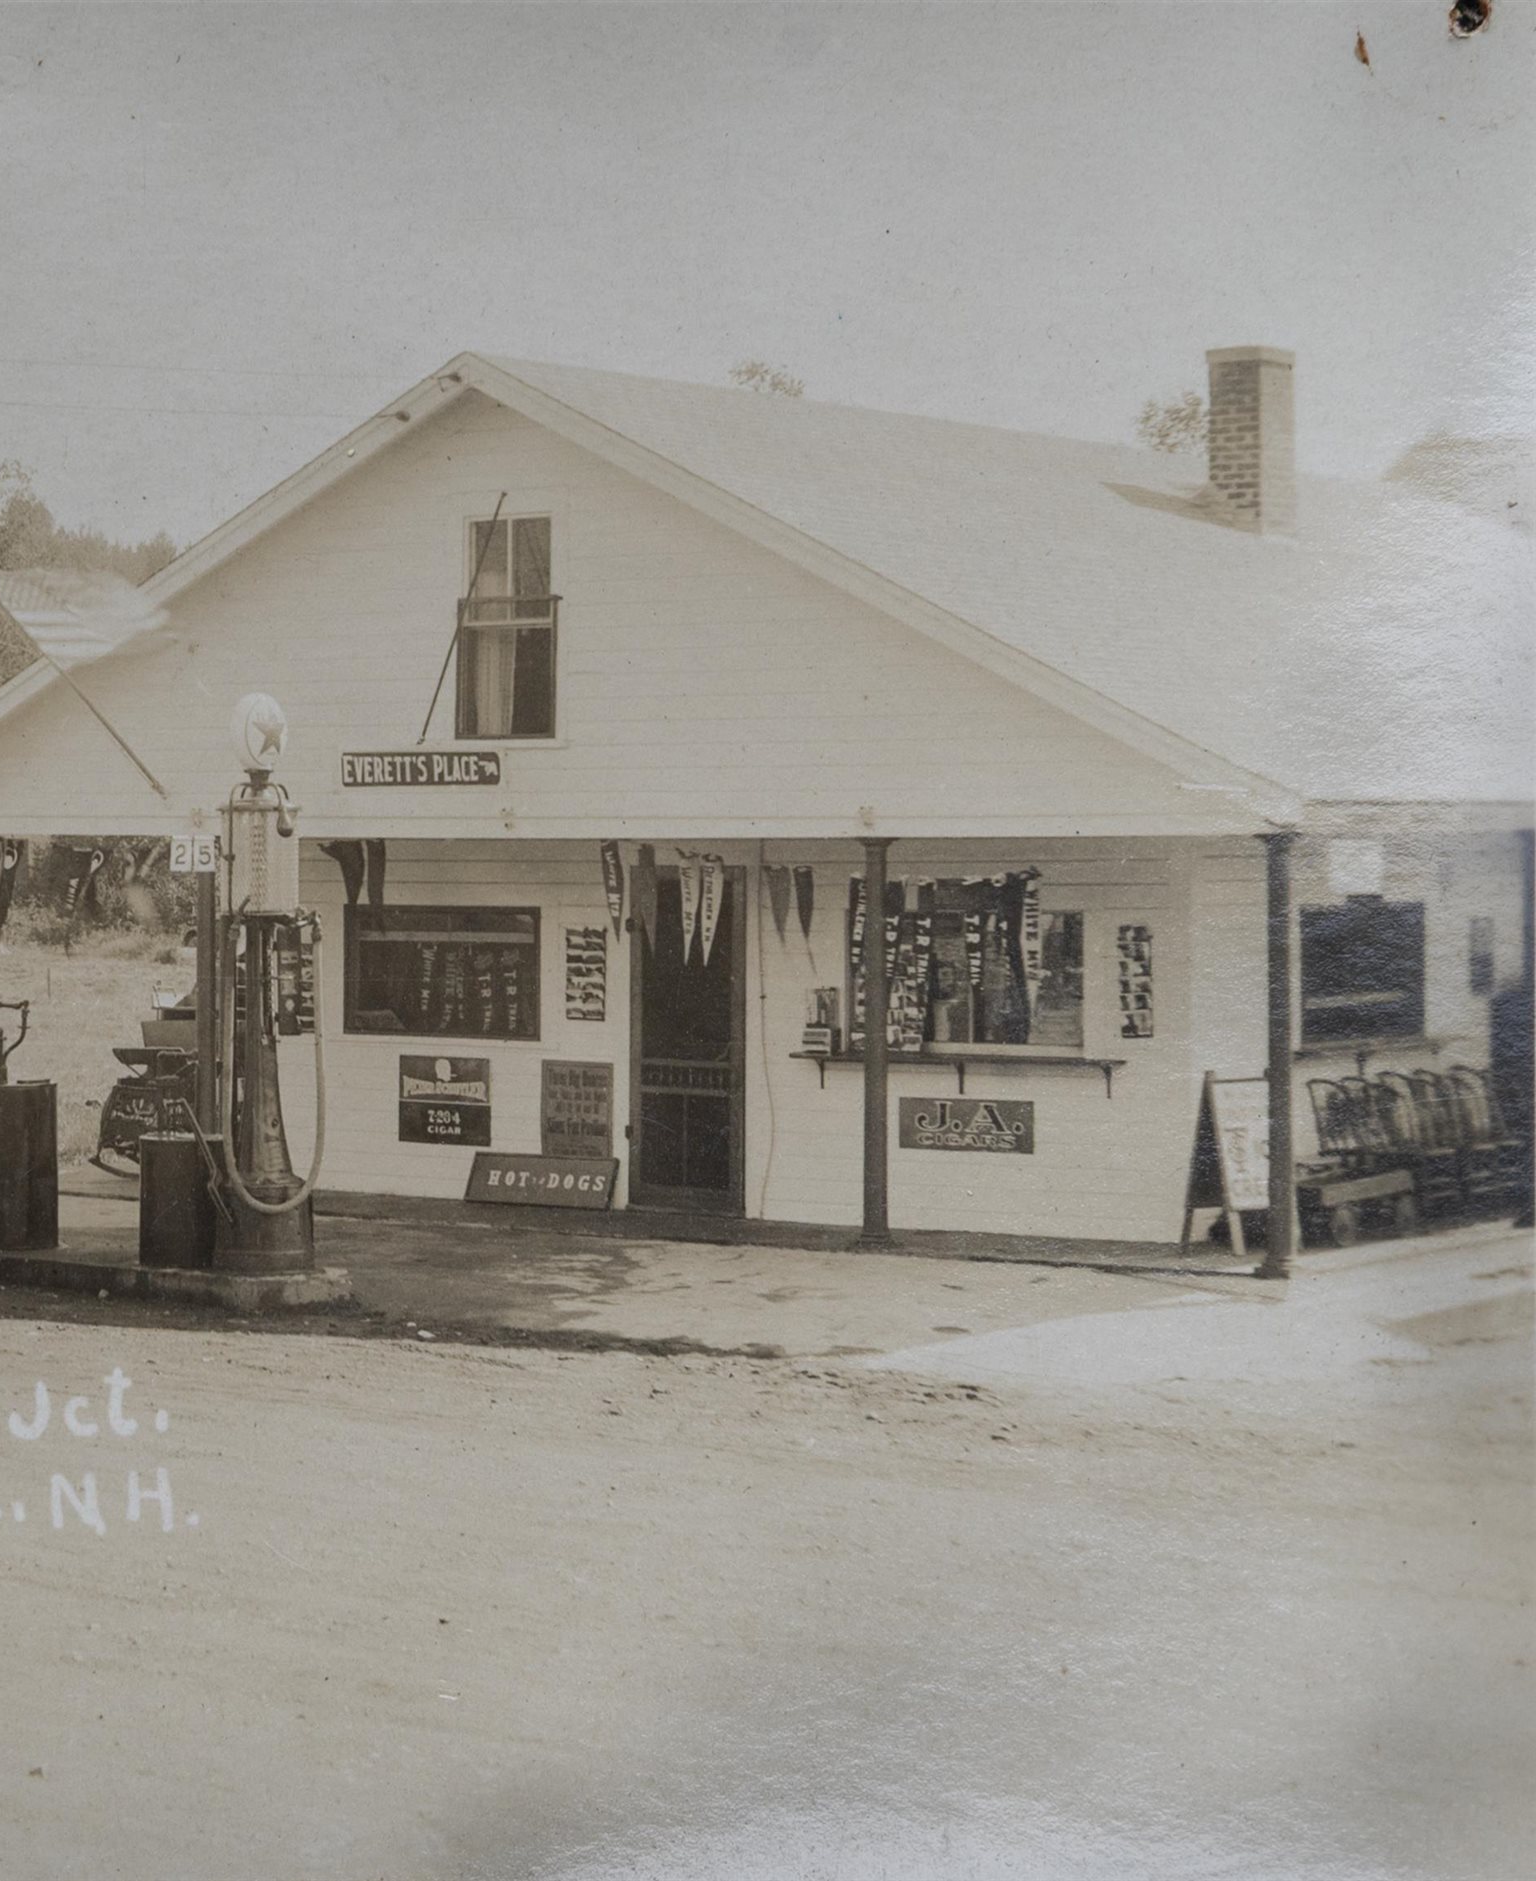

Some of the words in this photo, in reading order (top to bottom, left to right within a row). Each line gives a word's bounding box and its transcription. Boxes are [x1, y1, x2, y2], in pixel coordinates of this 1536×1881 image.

[343, 755, 428, 783] EVERETT'S
[432, 754, 480, 782] PLACE
[1026, 888, 1039, 941] WHITE
[426, 1125, 462, 1135] CIGAR
[915, 1100, 1025, 1135] J.A.
[916, 1132, 1017, 1149] CIGARS
[487, 1169, 531, 1188] HOT
[546, 1171, 606, 1192] DOGS
